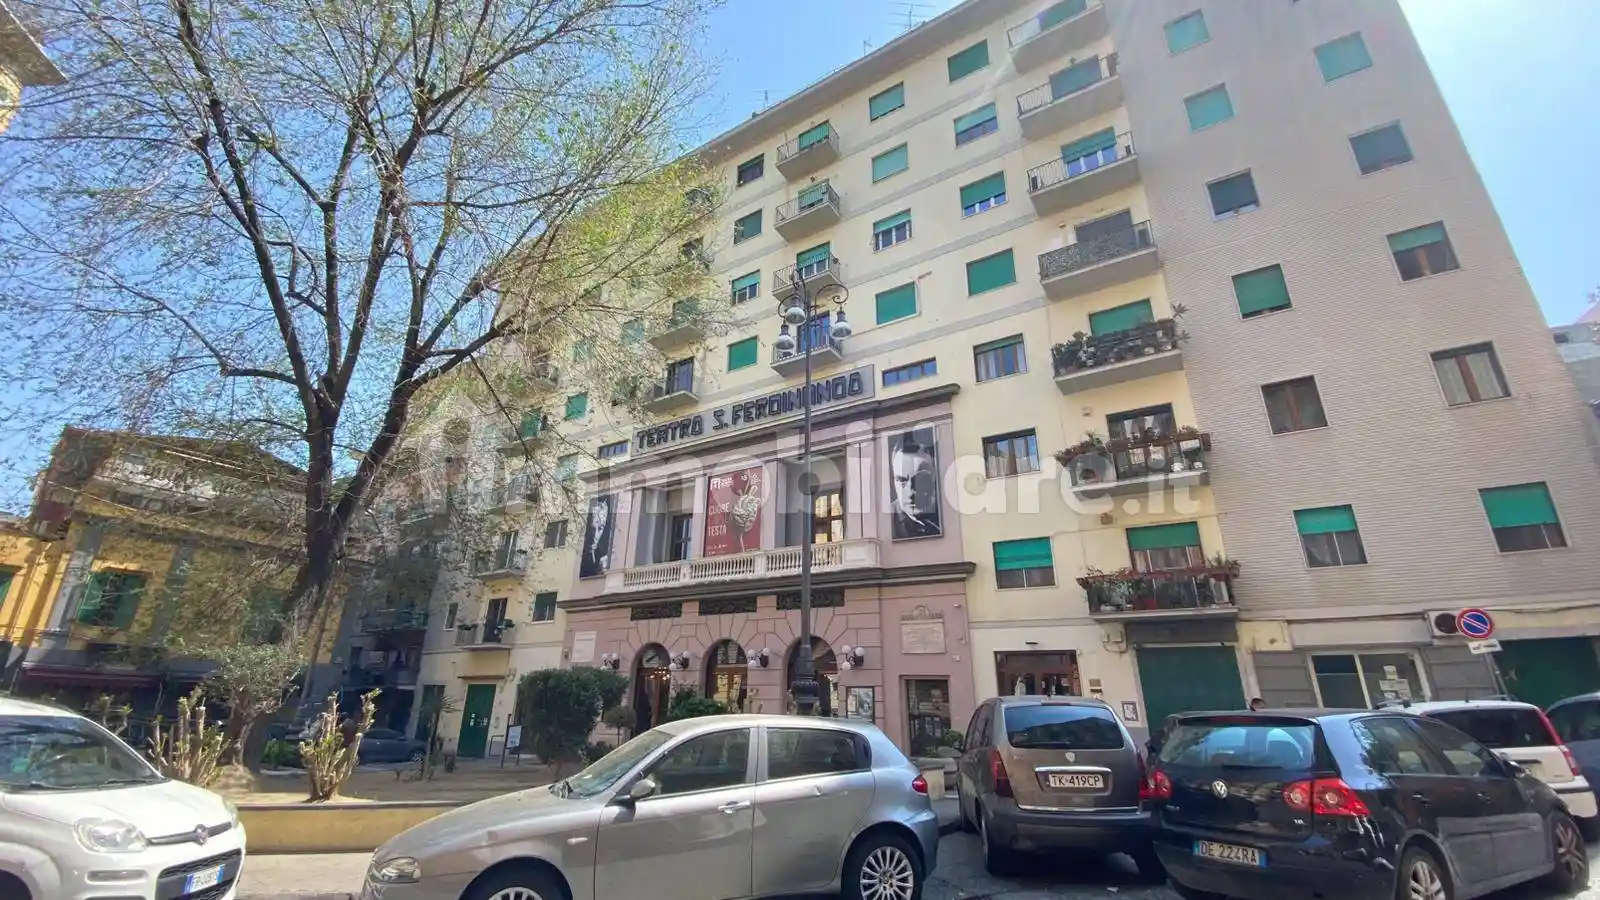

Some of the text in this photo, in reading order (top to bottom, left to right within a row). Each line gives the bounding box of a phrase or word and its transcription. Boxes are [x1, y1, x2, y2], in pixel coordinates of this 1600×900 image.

[636, 414, 704, 449] TEATRO
[708, 523, 728, 537] TESTA
[1219, 844, 1257, 863] 224RA
